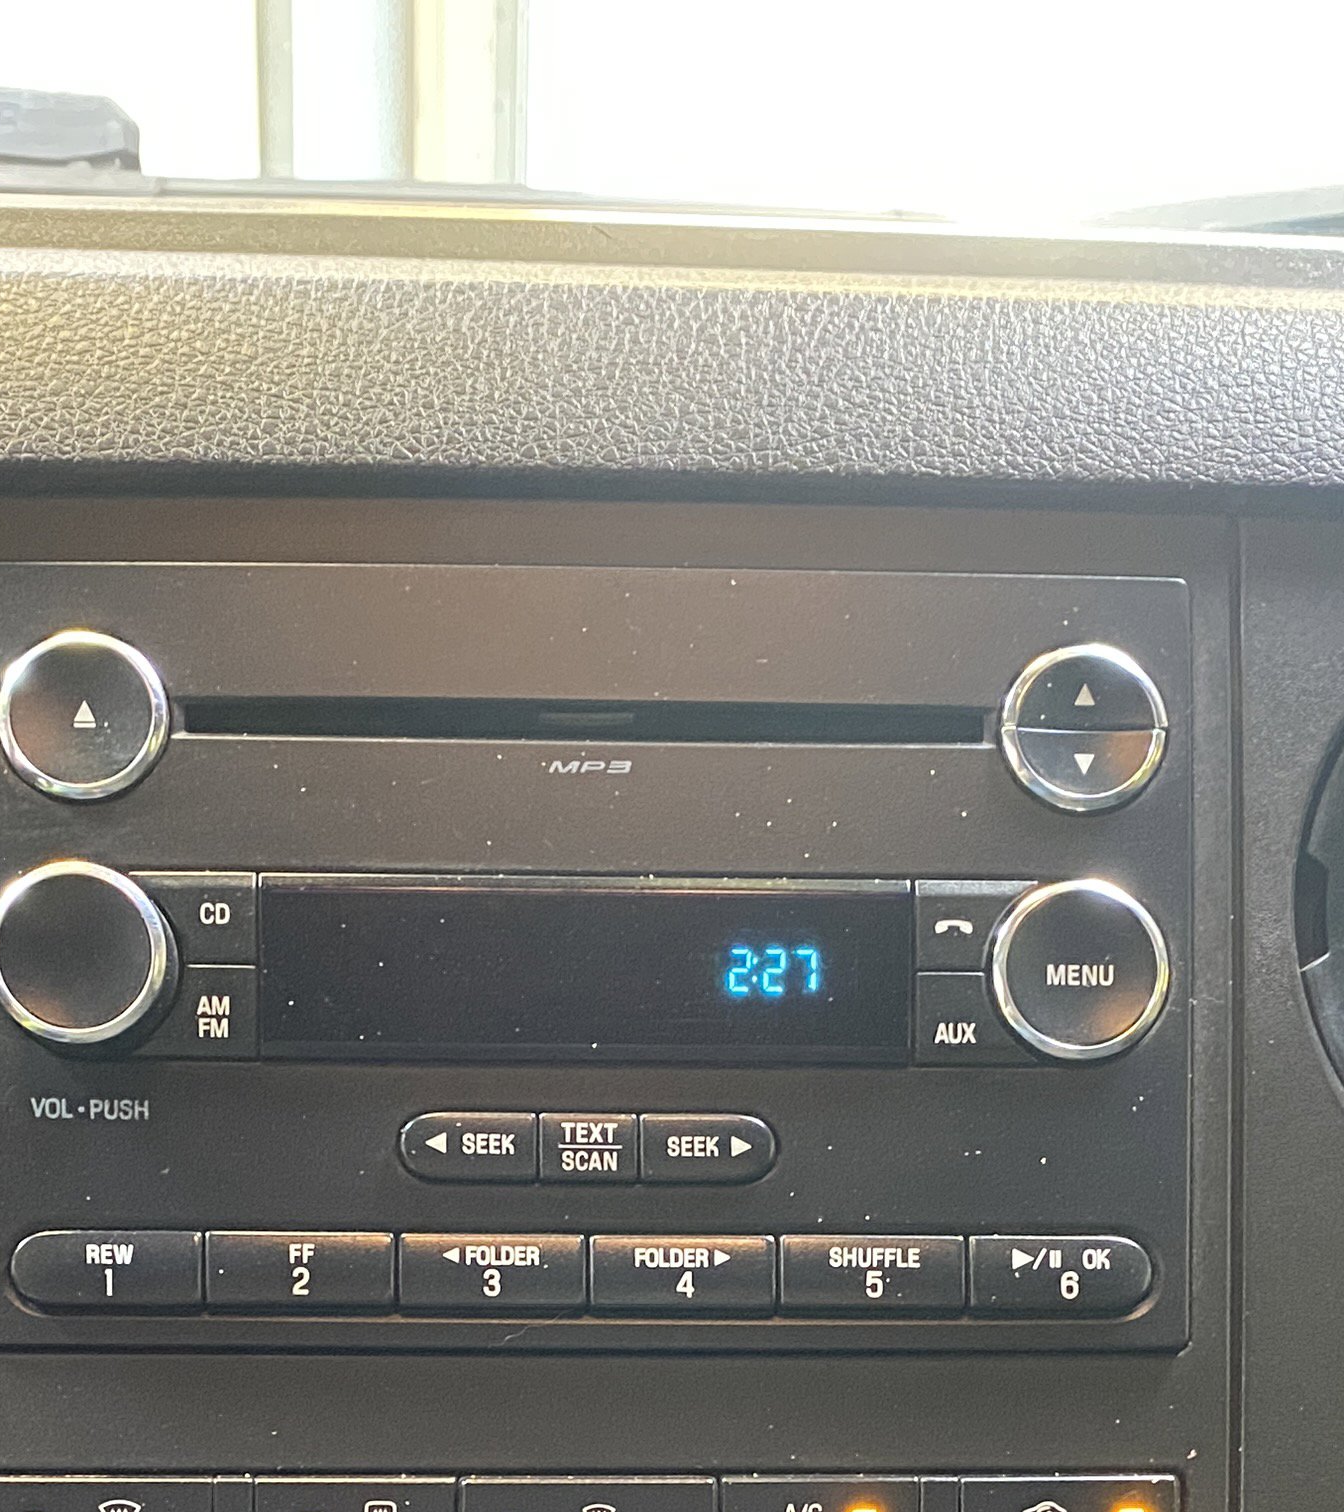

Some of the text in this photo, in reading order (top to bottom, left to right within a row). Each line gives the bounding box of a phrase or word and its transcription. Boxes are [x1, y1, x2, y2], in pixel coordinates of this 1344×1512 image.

[548, 760, 633, 774] MP3
[199, 902, 231, 925] CD
[727, 948, 818, 993] 2:27
[1046, 963, 1114, 988] MENU
[196, 995, 230, 1016] AM
[198, 1017, 229, 1038] FM
[934, 1022, 977, 1045] AUX
[461, 1132, 515, 1155] SEEK
[560, 1121, 619, 1144] TEXT
[667, 1135, 720, 1157] SEEK
[561, 1150, 618, 1172] SCAN
[85, 1243, 134, 1265] REW
[288, 1242, 316, 1264] FF
[465, 1244, 540, 1267] FOLDER
[633, 1246, 710, 1269] FOLDER
[828, 1246, 921, 1269] SHUFFLE
[1082, 1248, 1111, 1270] OK
[104, 1268, 113, 1297] 1
[292, 1267, 310, 1296] 2
[482, 1268, 501, 1297] 3
[675, 1270, 695, 1299] 4
[865, 1270, 884, 1299] 5
[1060, 1270, 1080, 1300] 6
